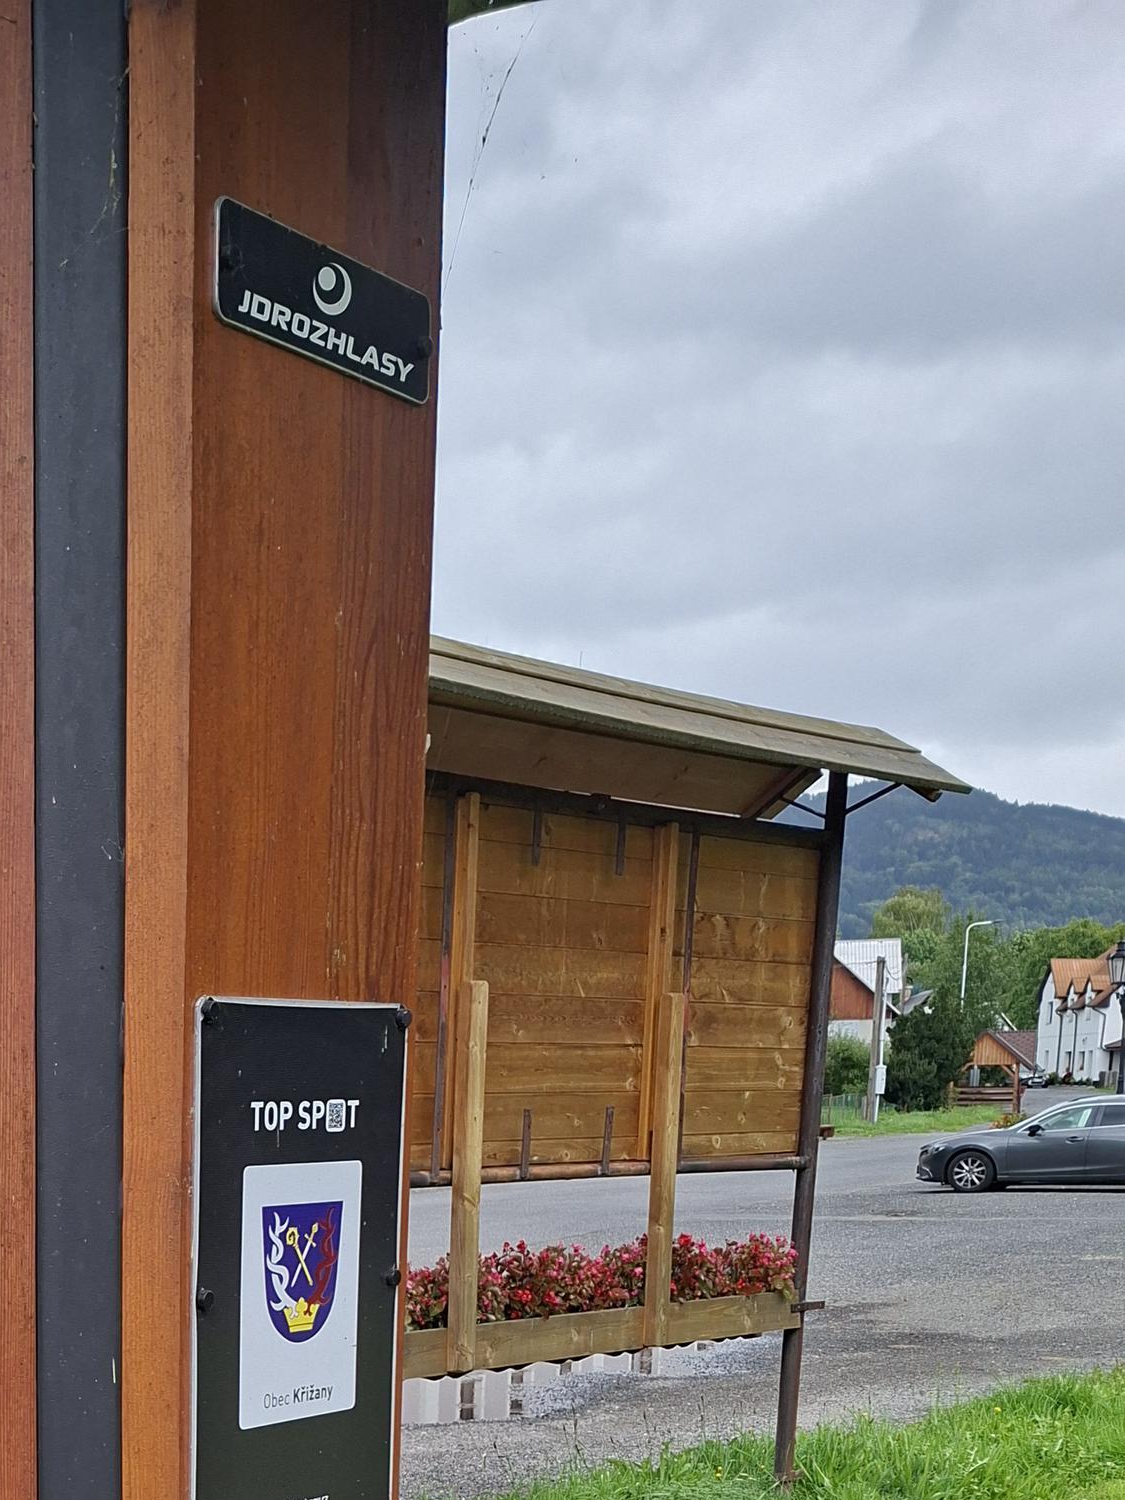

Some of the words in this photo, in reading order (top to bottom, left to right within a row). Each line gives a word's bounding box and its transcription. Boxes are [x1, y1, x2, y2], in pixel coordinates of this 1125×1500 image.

[238, 289, 414, 383] JDROZHLASY
[250, 1101, 293, 1131] TOP
[263, 1393, 290, 1408] Obec
[293, 1384, 334, 1404] Křižany
